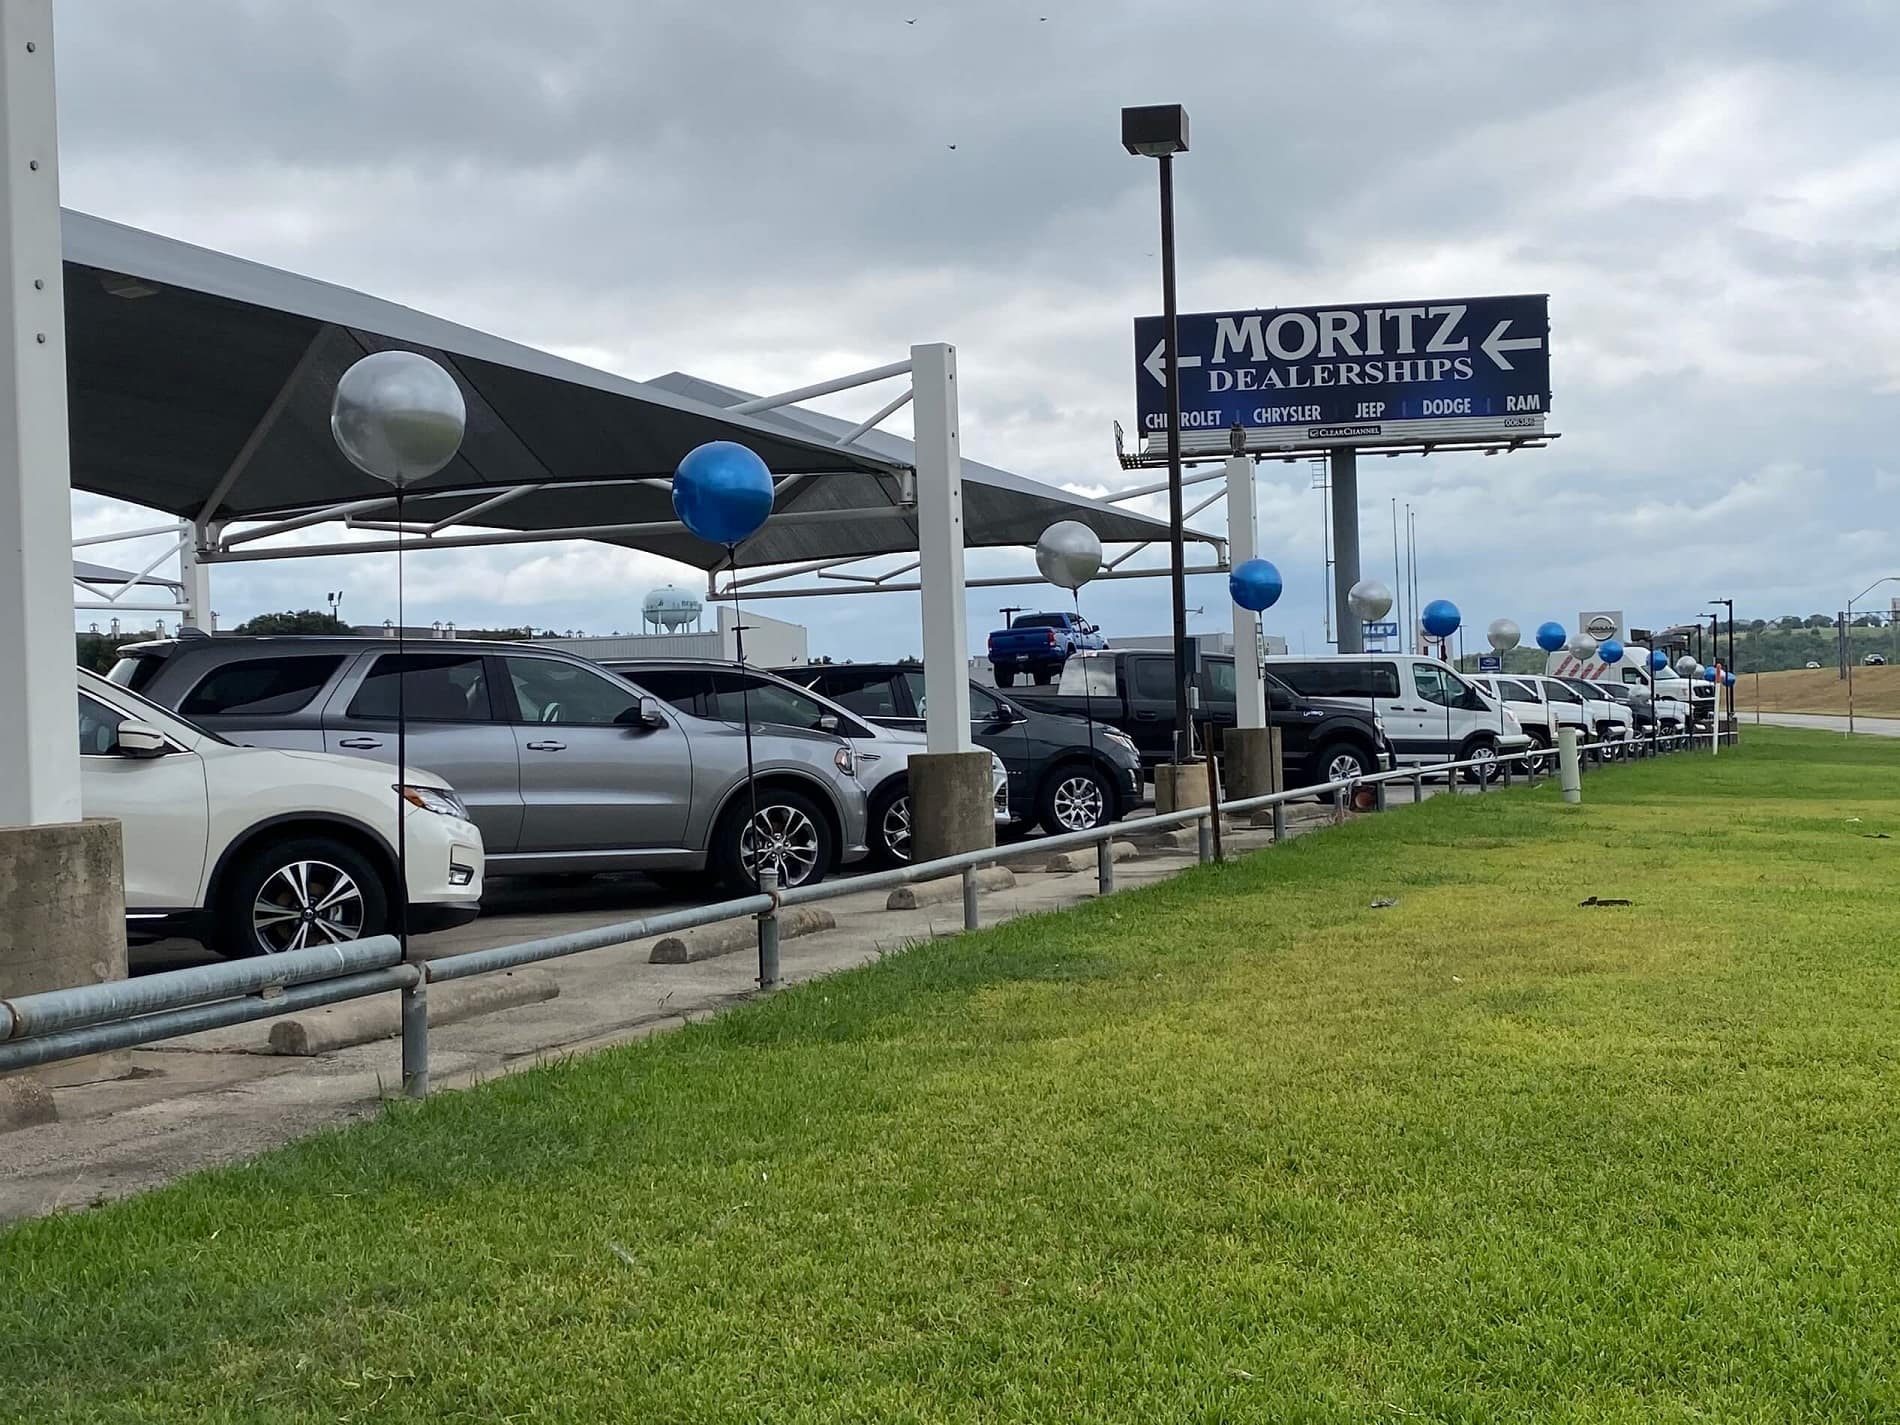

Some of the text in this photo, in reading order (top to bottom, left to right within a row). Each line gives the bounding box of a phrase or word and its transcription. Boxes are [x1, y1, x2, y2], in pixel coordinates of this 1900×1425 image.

[1211, 305, 1469, 363] MORITZ
[1208, 357, 1474, 392] DEALERSHIPS
[1145, 394, 1541, 429] CHROLET CHRYSLER JEEP DODGE RAM
